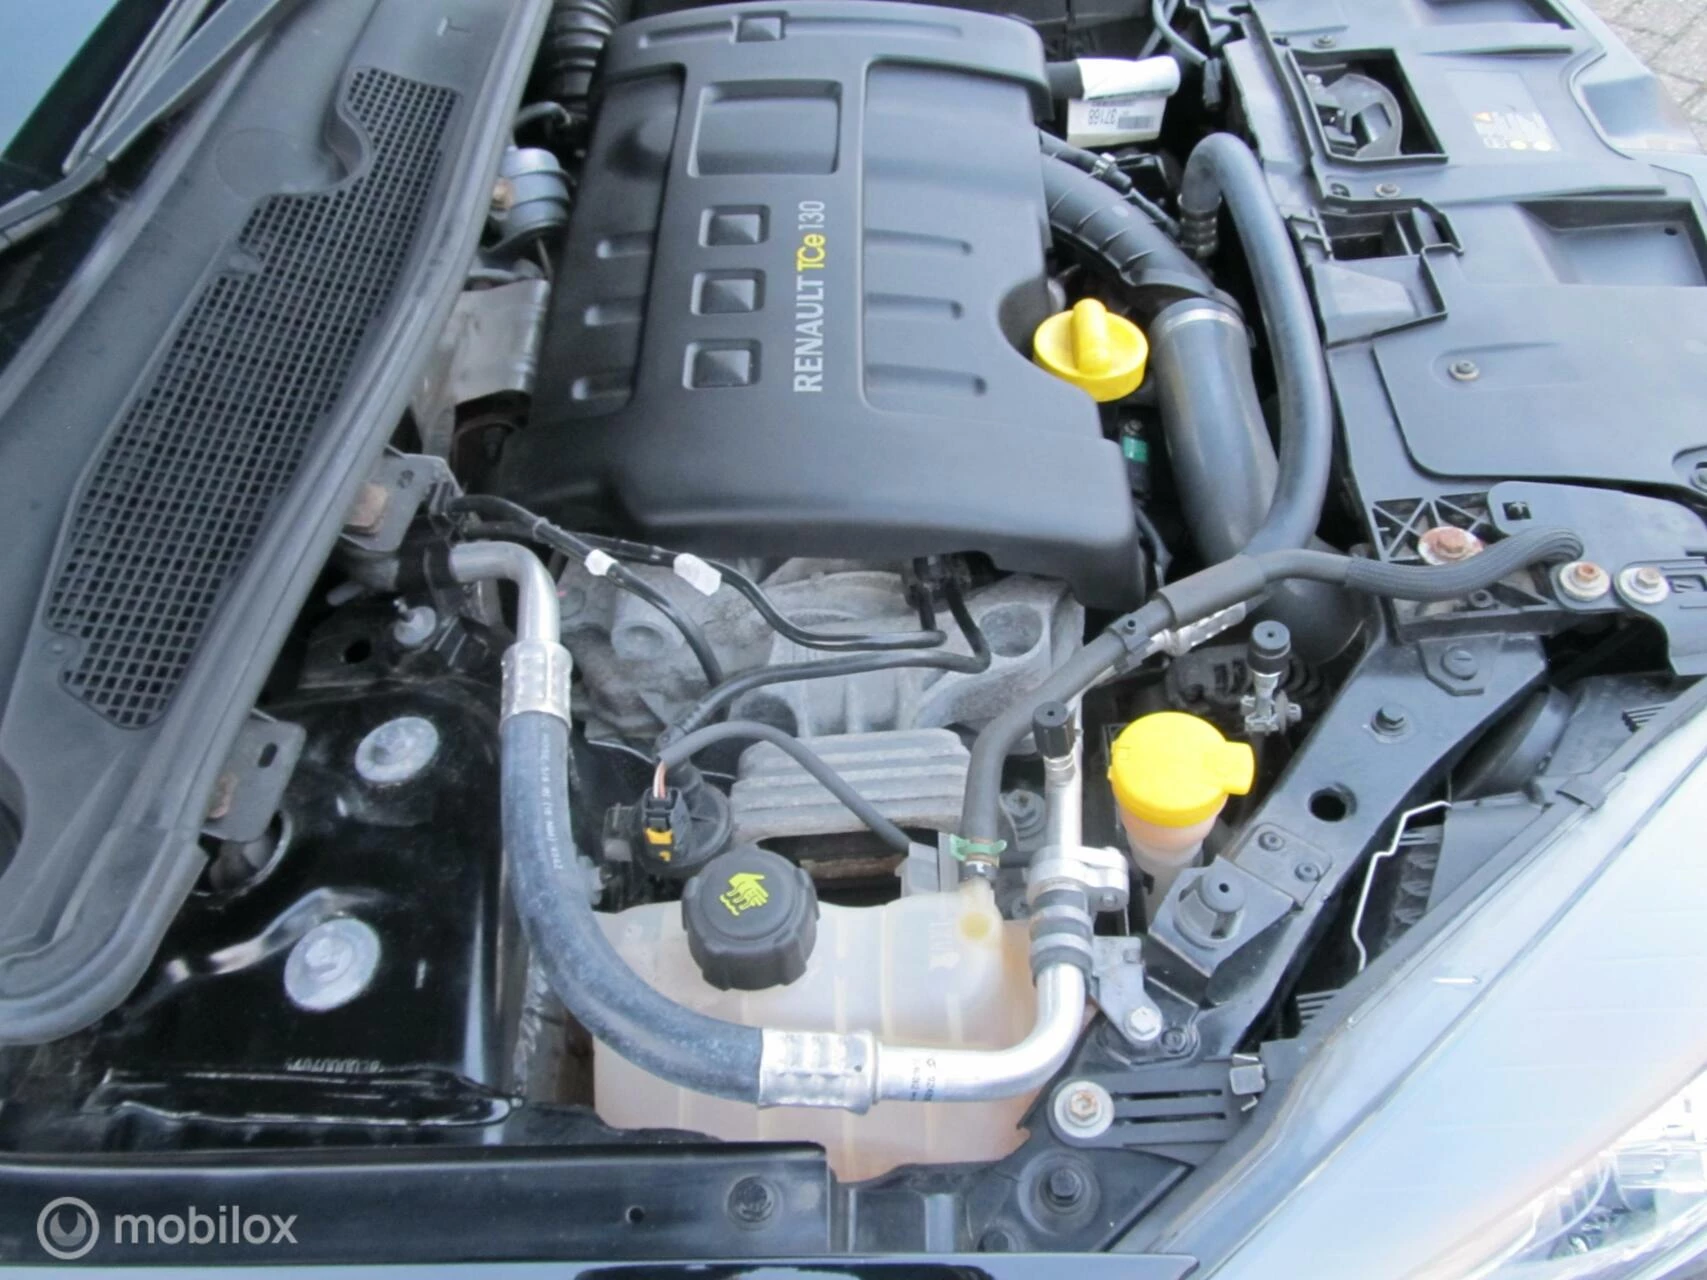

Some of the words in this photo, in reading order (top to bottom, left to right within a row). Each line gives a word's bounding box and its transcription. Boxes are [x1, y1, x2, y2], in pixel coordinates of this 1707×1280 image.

[798, 200, 825, 230] 130
[796, 233, 826, 272] TCe
[793, 275, 825, 392] RENAULT
